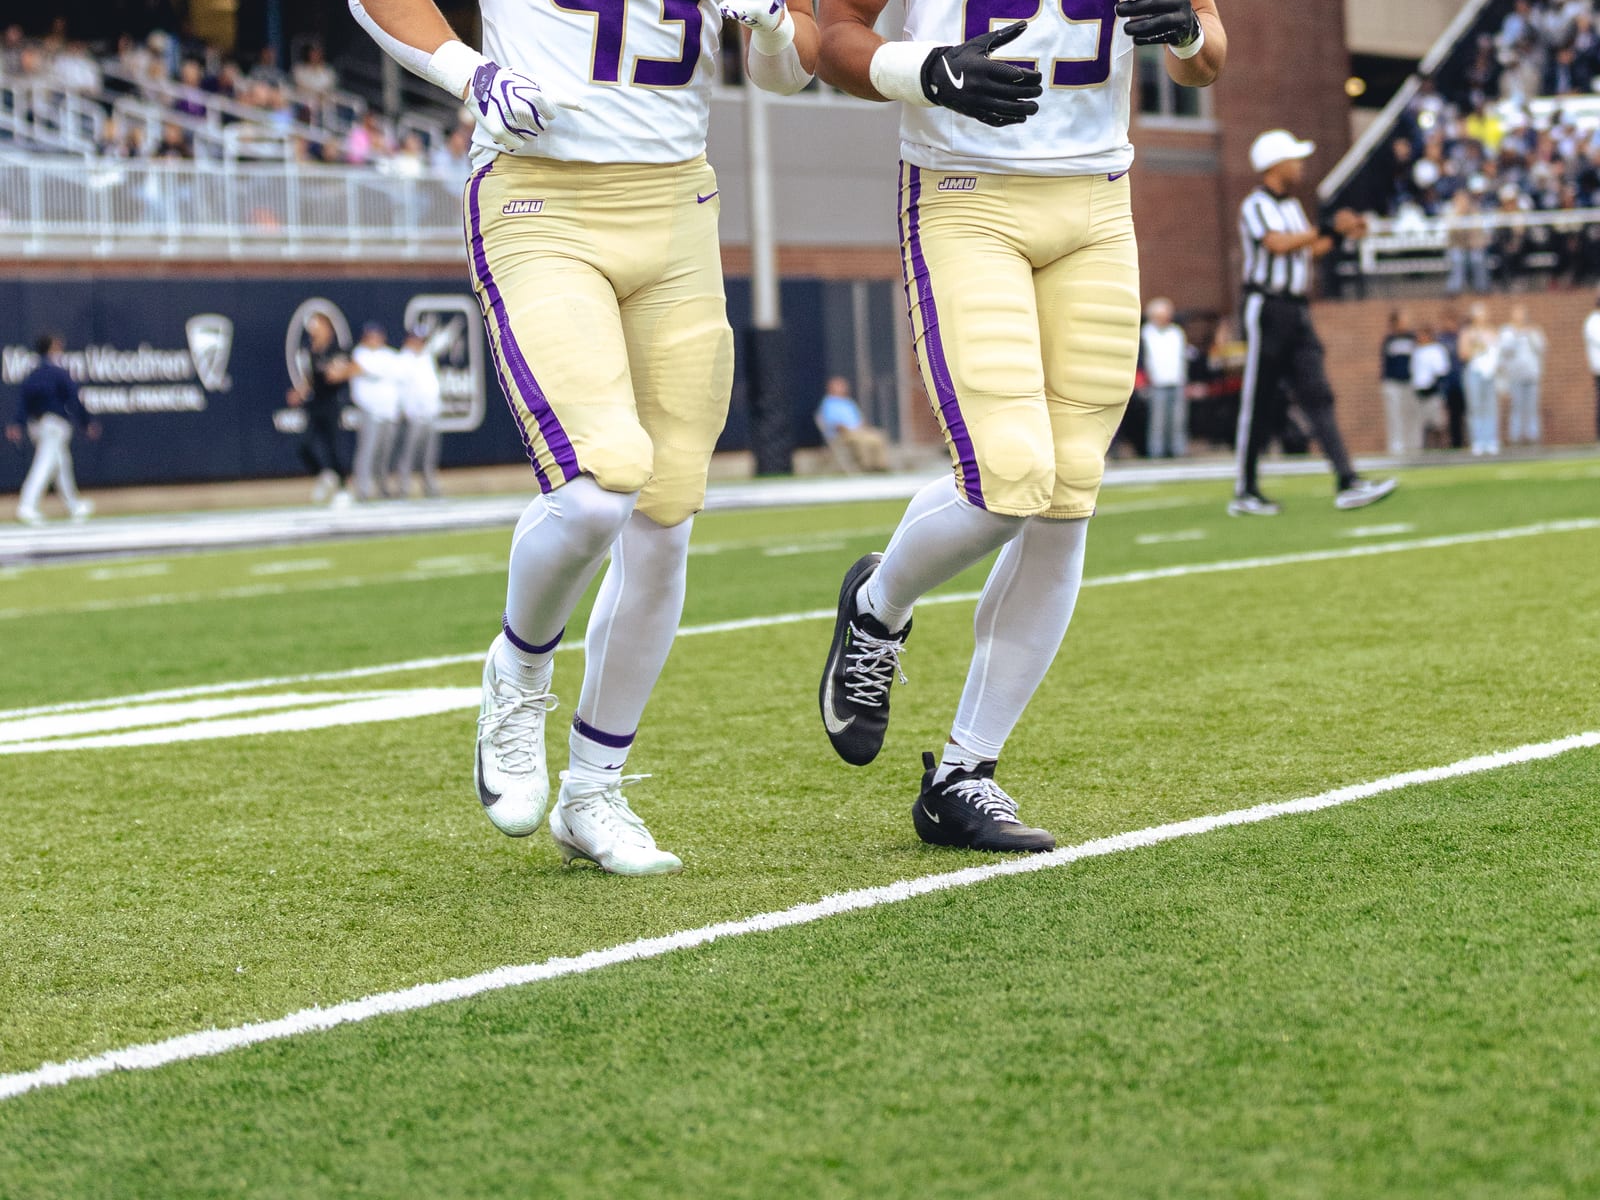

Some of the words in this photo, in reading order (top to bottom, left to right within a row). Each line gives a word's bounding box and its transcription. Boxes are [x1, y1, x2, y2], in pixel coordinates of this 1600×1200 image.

[938, 177, 976, 191] JMU
[503, 200, 545, 214] JMU
[85, 342, 195, 382] Woodmen
